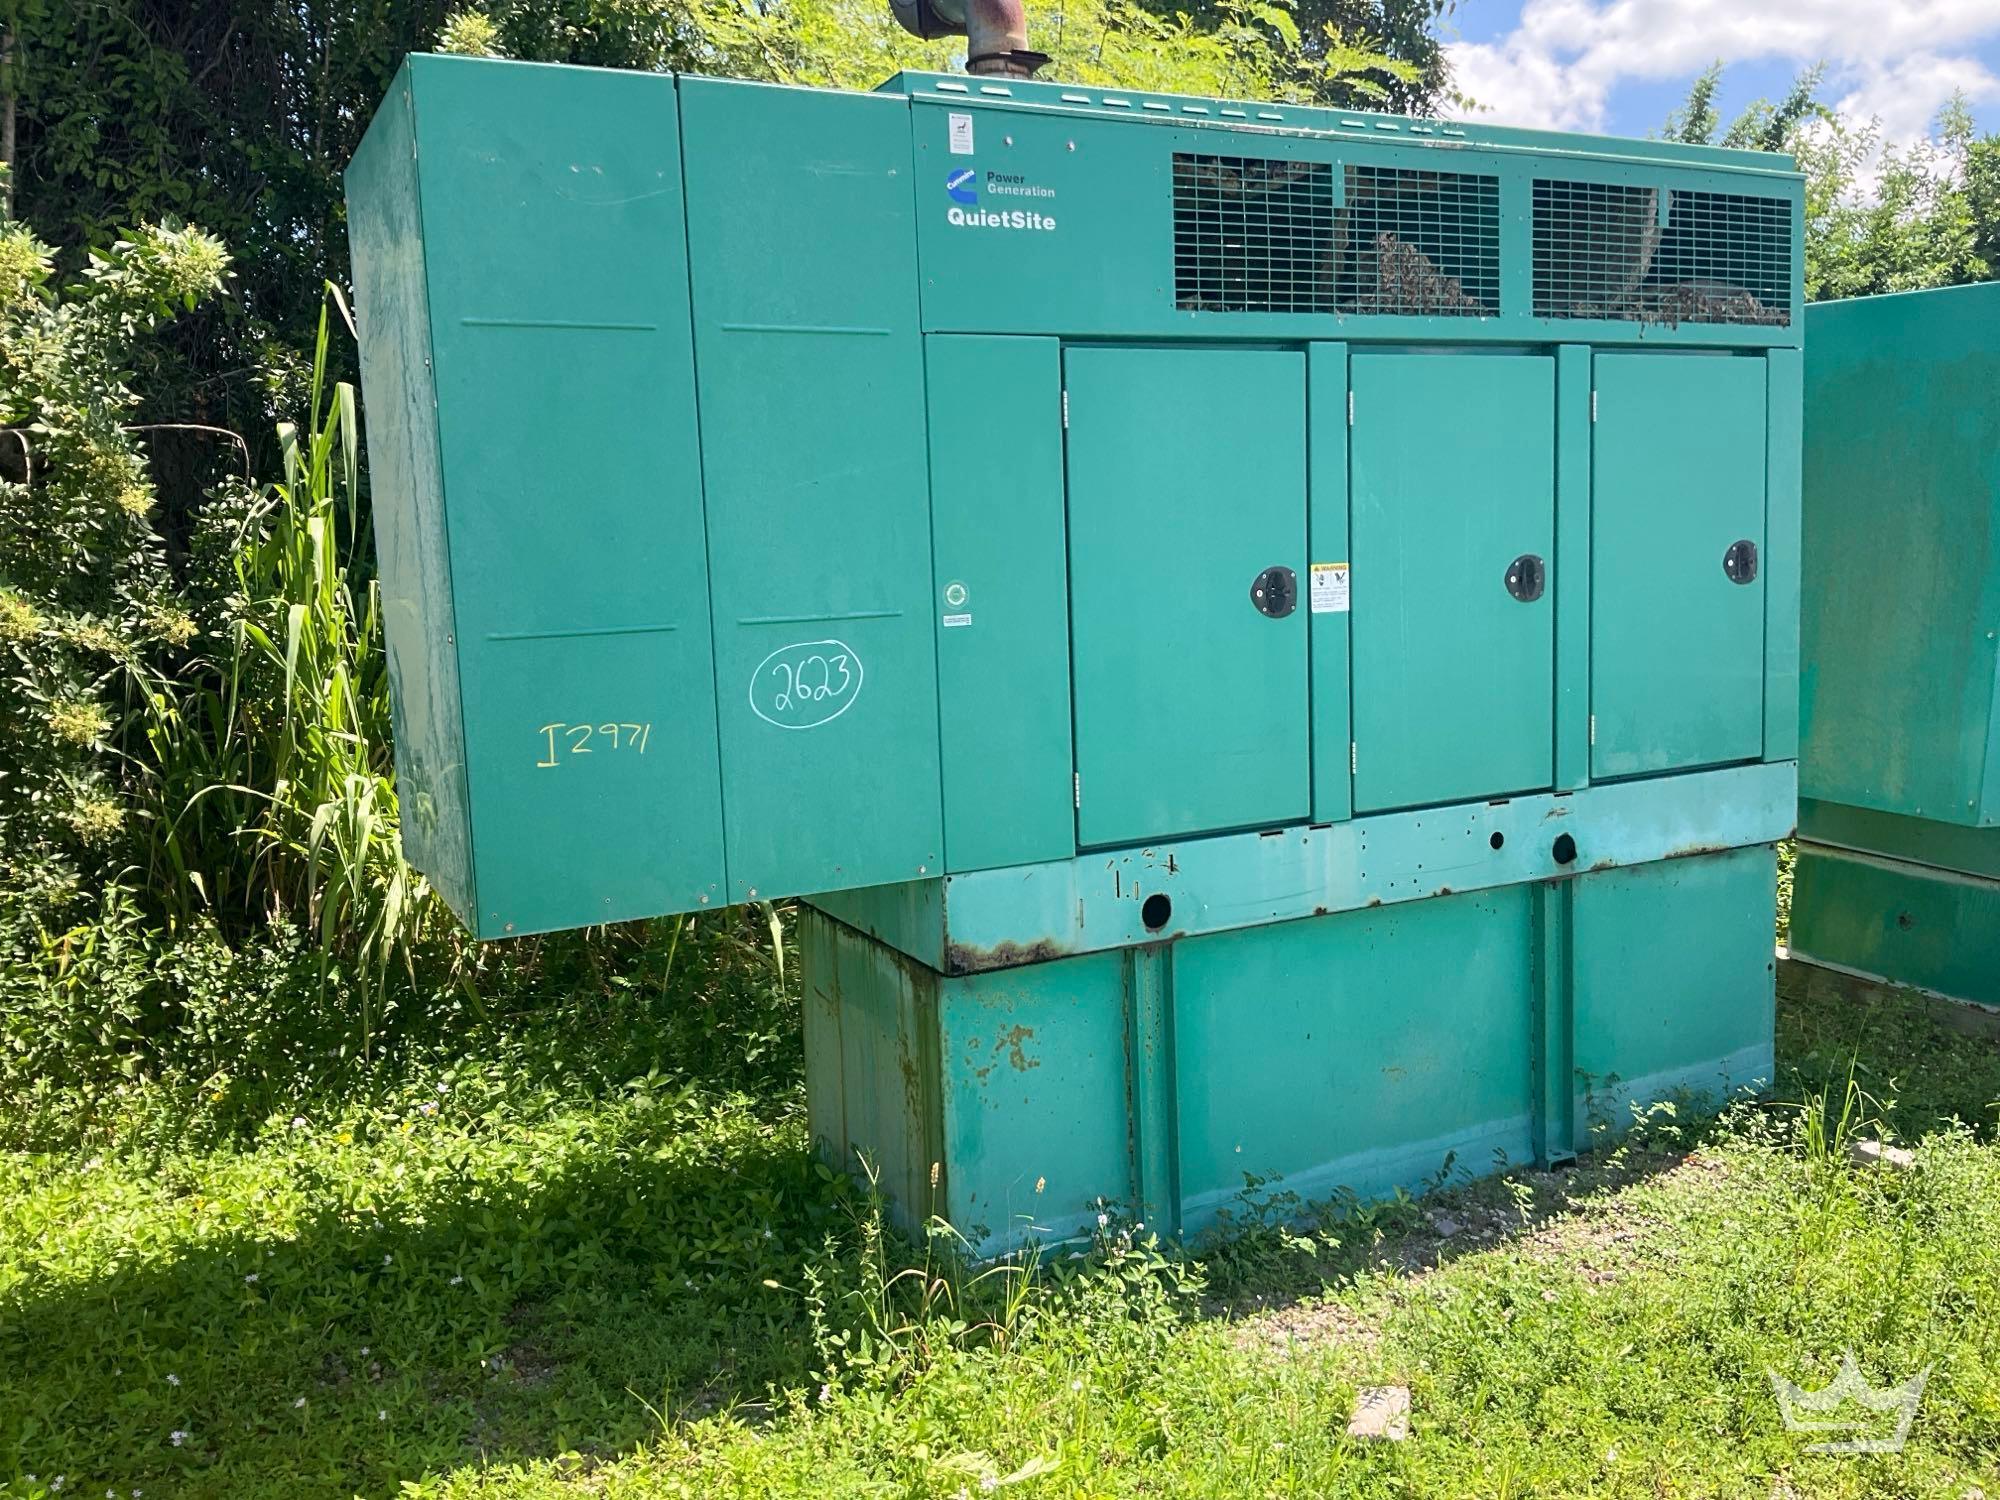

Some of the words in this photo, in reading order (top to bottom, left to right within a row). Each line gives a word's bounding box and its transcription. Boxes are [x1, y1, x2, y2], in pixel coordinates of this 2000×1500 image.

[947, 169, 975, 190] Cummins
[986, 171, 1025, 184] Power
[987, 183, 1055, 197] Generation
[947, 207, 1056, 230] QuietSite
[772, 654, 850, 711] 2623
